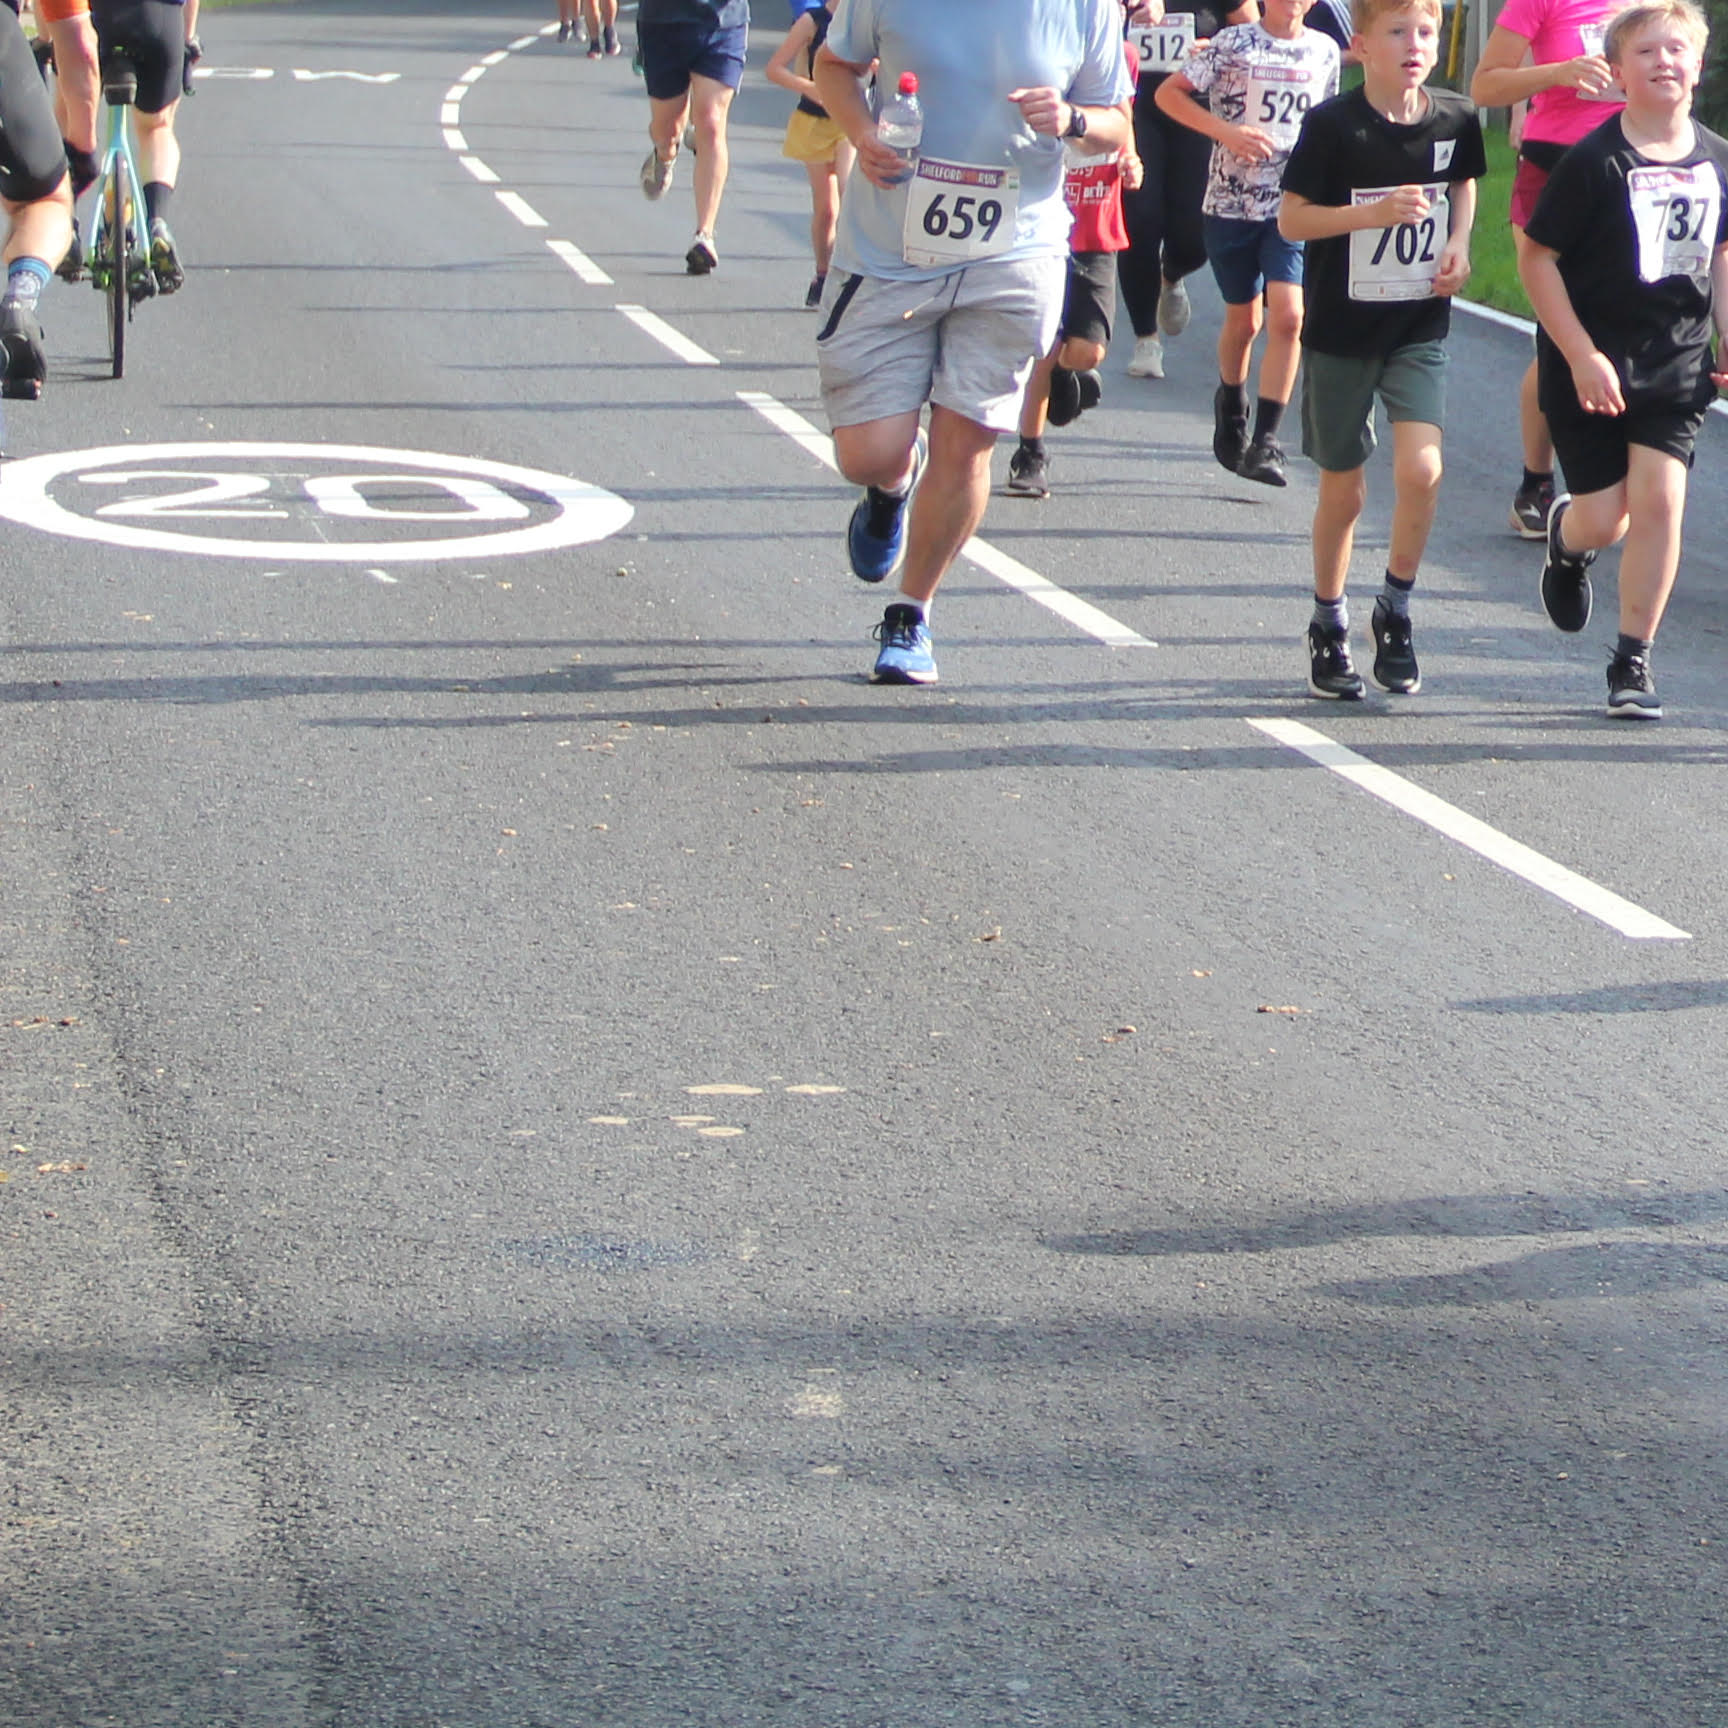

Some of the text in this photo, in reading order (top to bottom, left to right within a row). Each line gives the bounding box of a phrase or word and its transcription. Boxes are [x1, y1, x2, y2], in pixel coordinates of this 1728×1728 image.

[1139, 34, 1185, 61] 512
[192, 68, 401, 83] OW
[1258, 89, 1312, 124] 529
[923, 193, 1003, 243] 659
[1651, 197, 1710, 242] 737
[1370, 217, 1436, 266] 702
[78, 471, 531, 521] 20
